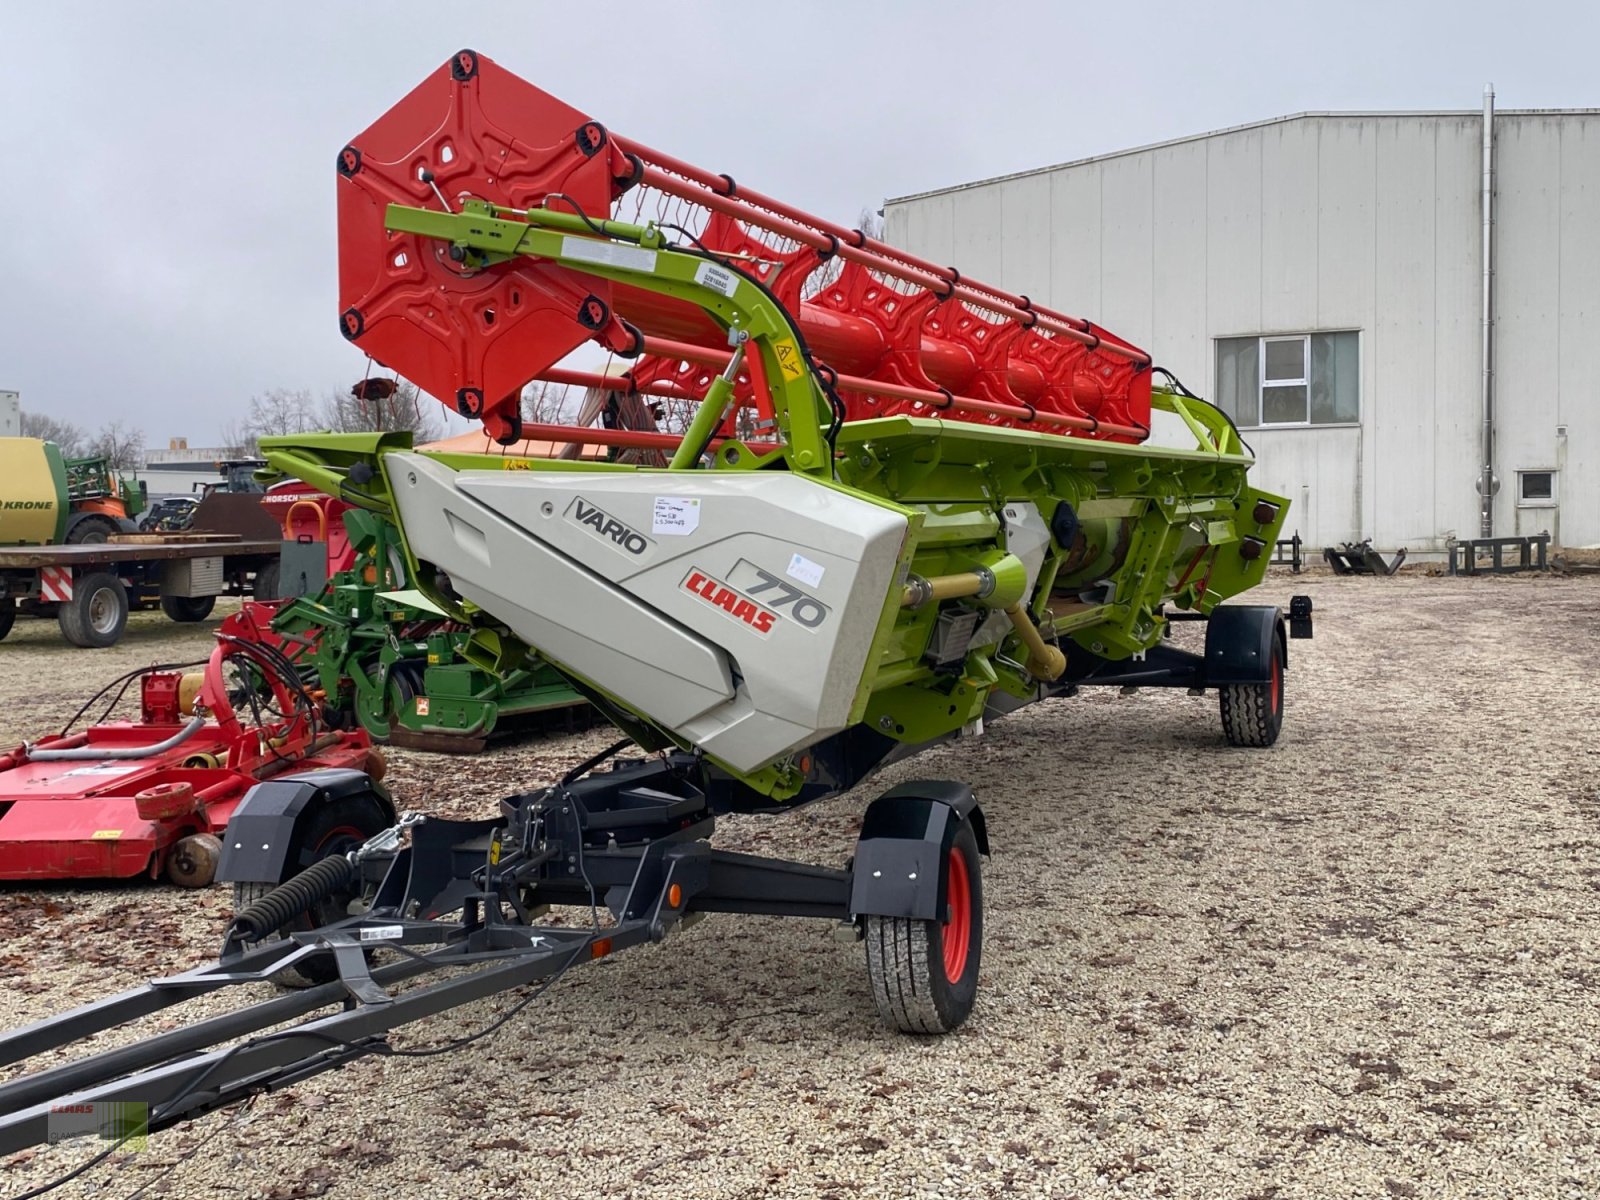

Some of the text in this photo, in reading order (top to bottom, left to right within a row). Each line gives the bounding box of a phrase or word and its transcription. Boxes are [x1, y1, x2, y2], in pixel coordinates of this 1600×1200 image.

[4, 501, 53, 509] KRONE
[266, 494, 298, 503] HORSCH
[575, 500, 648, 555] VARIO
[686, 572, 776, 633] CLAAS
[746, 571, 827, 628] 770
